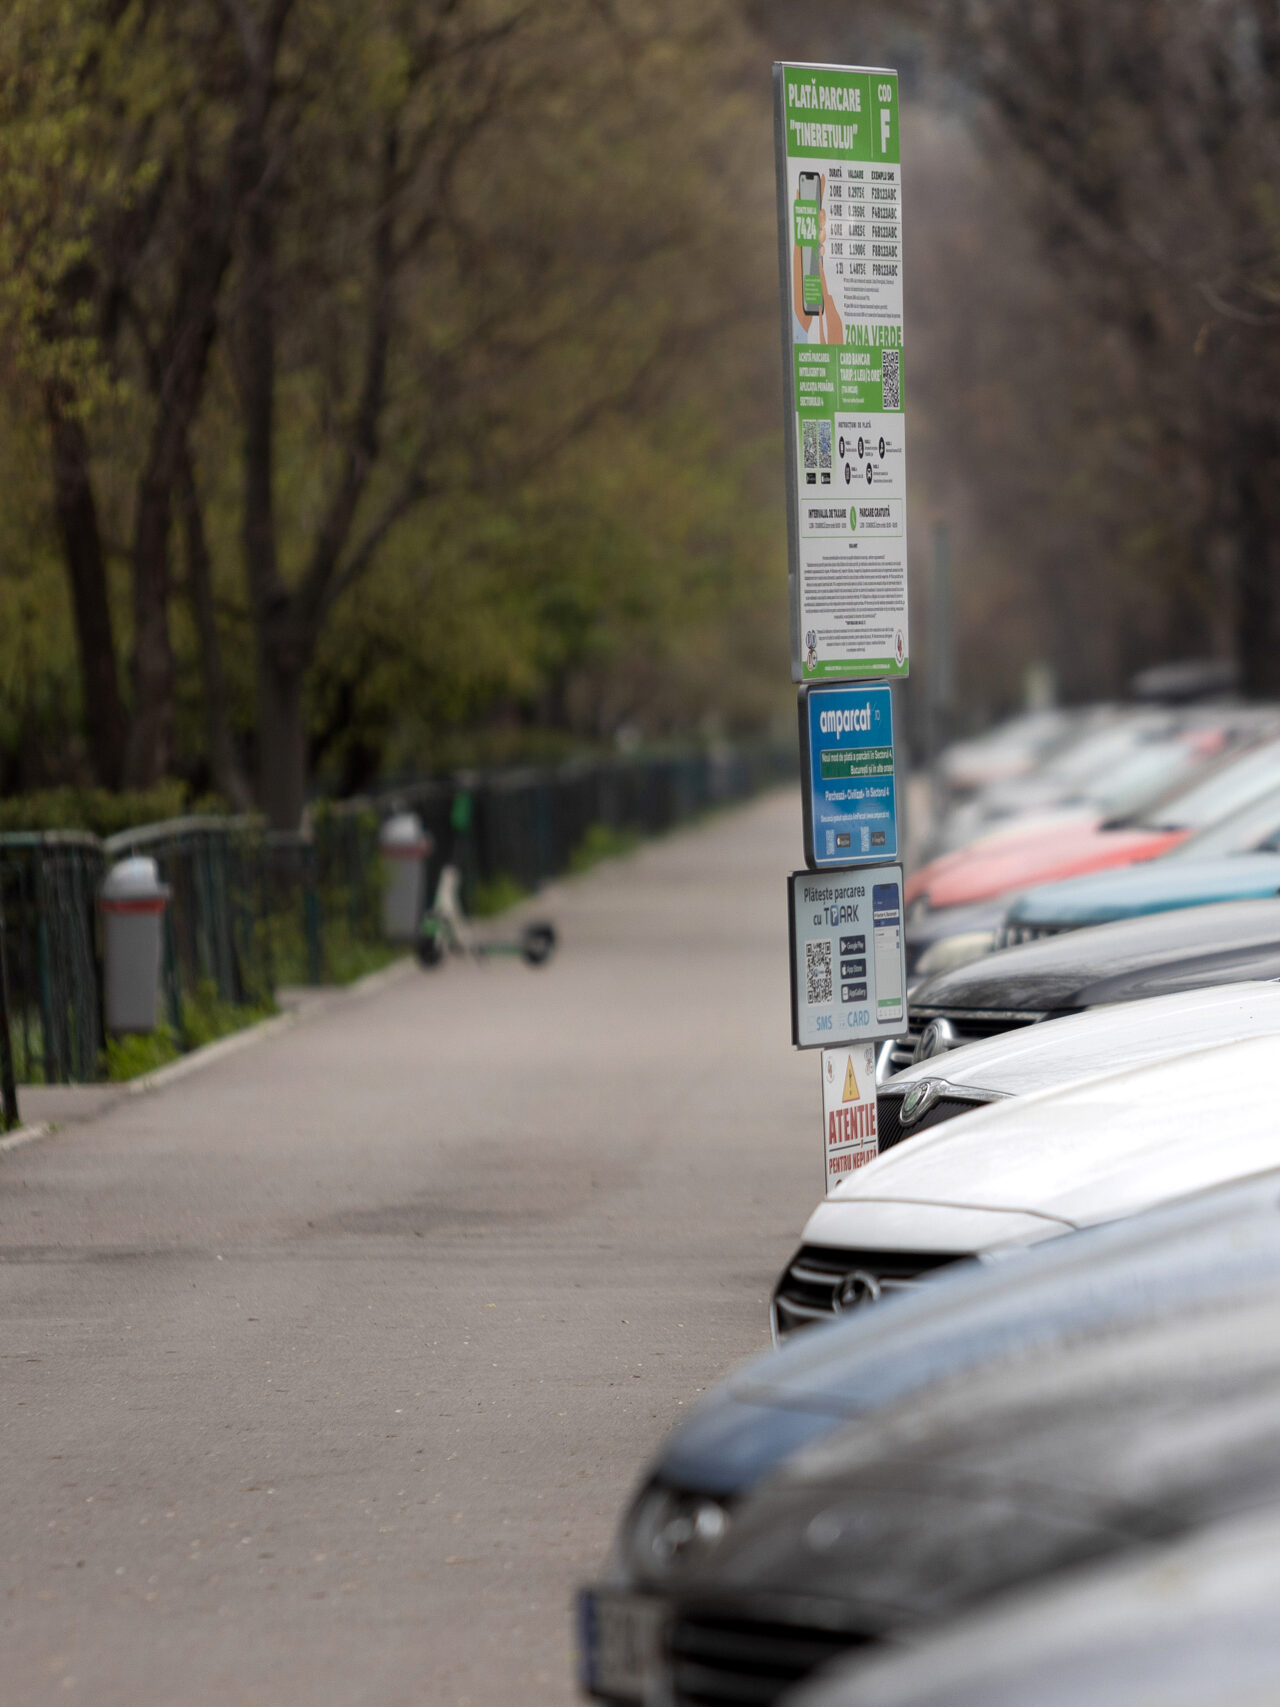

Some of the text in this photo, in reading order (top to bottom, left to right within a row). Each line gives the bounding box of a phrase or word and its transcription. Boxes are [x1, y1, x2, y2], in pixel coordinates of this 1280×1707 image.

[788, 78, 861, 112] PLATĂ PARCARE
[878, 84, 892, 102] COD
[880, 109, 891, 153] F
[833, 186, 842, 198] ORE
[833, 205, 842, 217] ORE
[796, 217, 817, 240] 7424
[845, 324, 901, 347] ZONA VERDE
[820, 702, 871, 740] amparcat
[804, 886, 865, 904] Plătește parcarea
[813, 914, 822, 926] cu
[816, 1010, 870, 1031] SMS CARD
[829, 1154, 851, 1175] PENTRU
